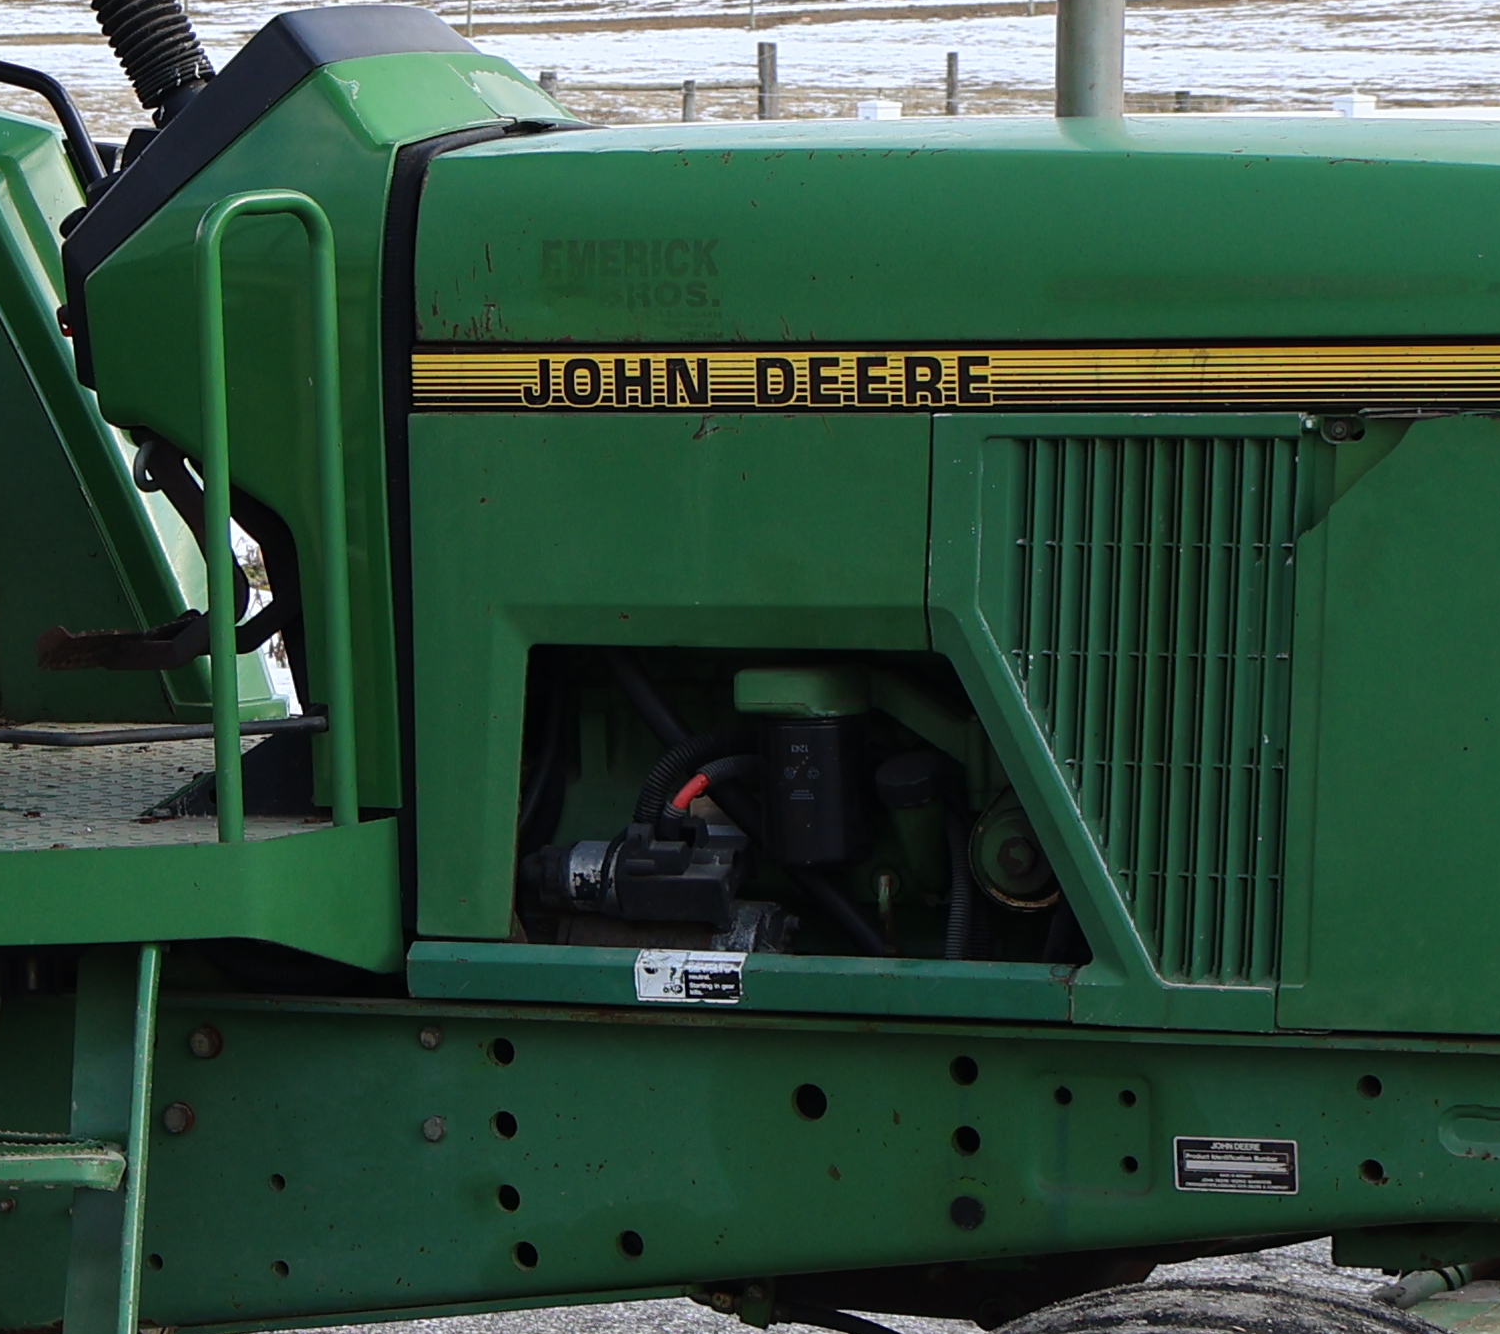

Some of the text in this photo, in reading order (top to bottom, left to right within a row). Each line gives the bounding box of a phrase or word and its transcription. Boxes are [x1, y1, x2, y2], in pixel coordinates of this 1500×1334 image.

[541, 238, 720, 279] EMERICK
[521, 355, 994, 407] JOHN DEERE
[689, 982, 713, 990] Starting
[1210, 1142, 1261, 1151] JOHN DEERE
